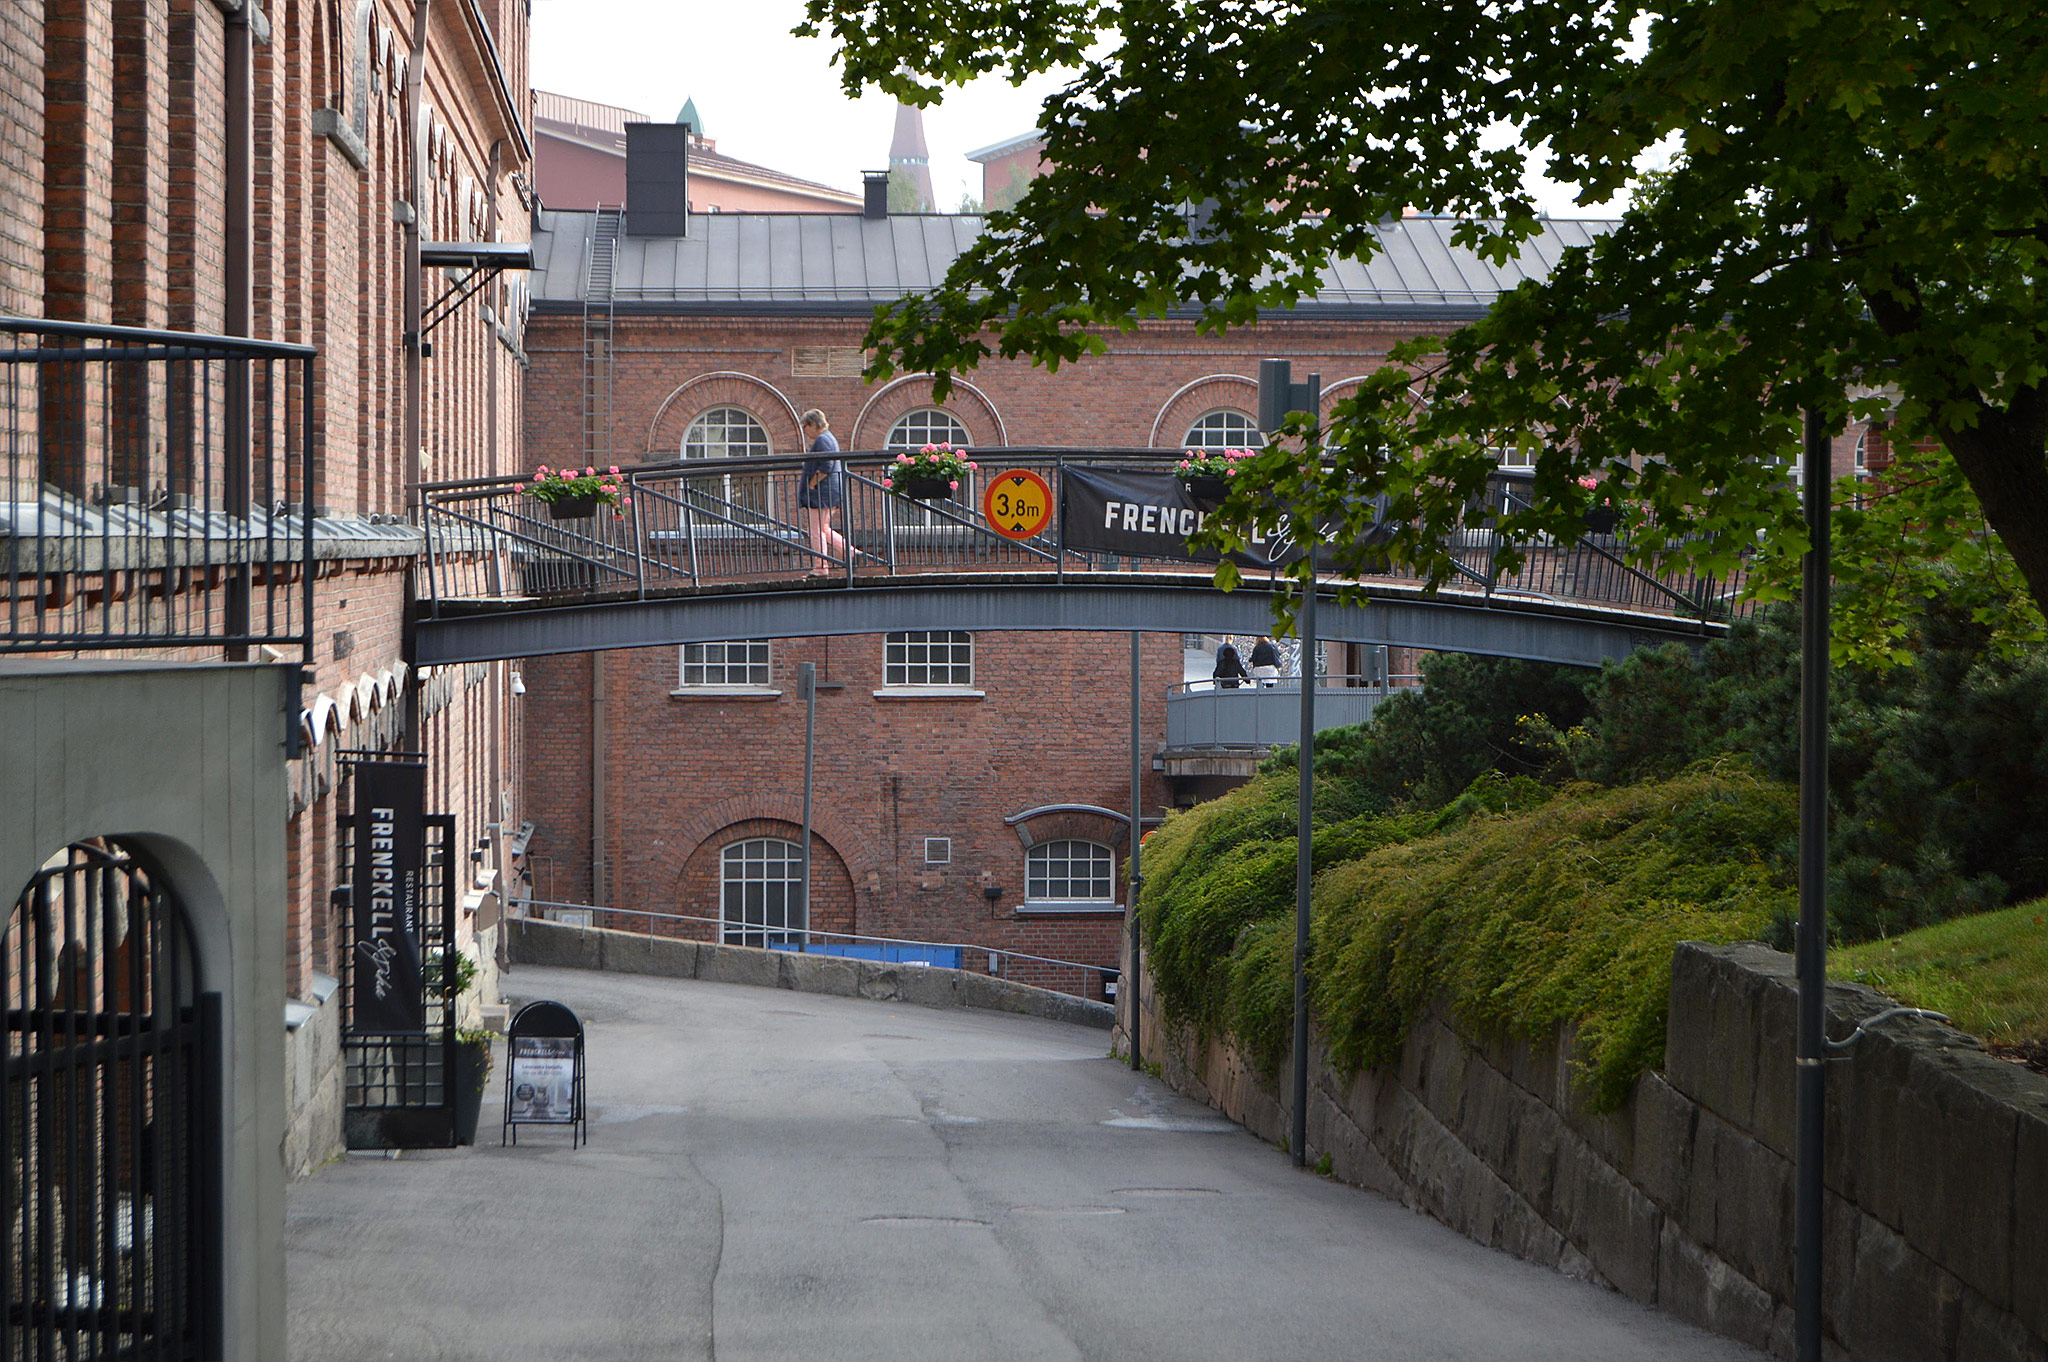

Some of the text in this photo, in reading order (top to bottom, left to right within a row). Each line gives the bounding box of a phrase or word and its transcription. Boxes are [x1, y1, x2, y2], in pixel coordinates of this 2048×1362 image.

[997, 493, 1040, 519] 3,8m
[371, 807, 395, 939] FRENCKELL
[403, 870, 415, 933] RESTAURANT
